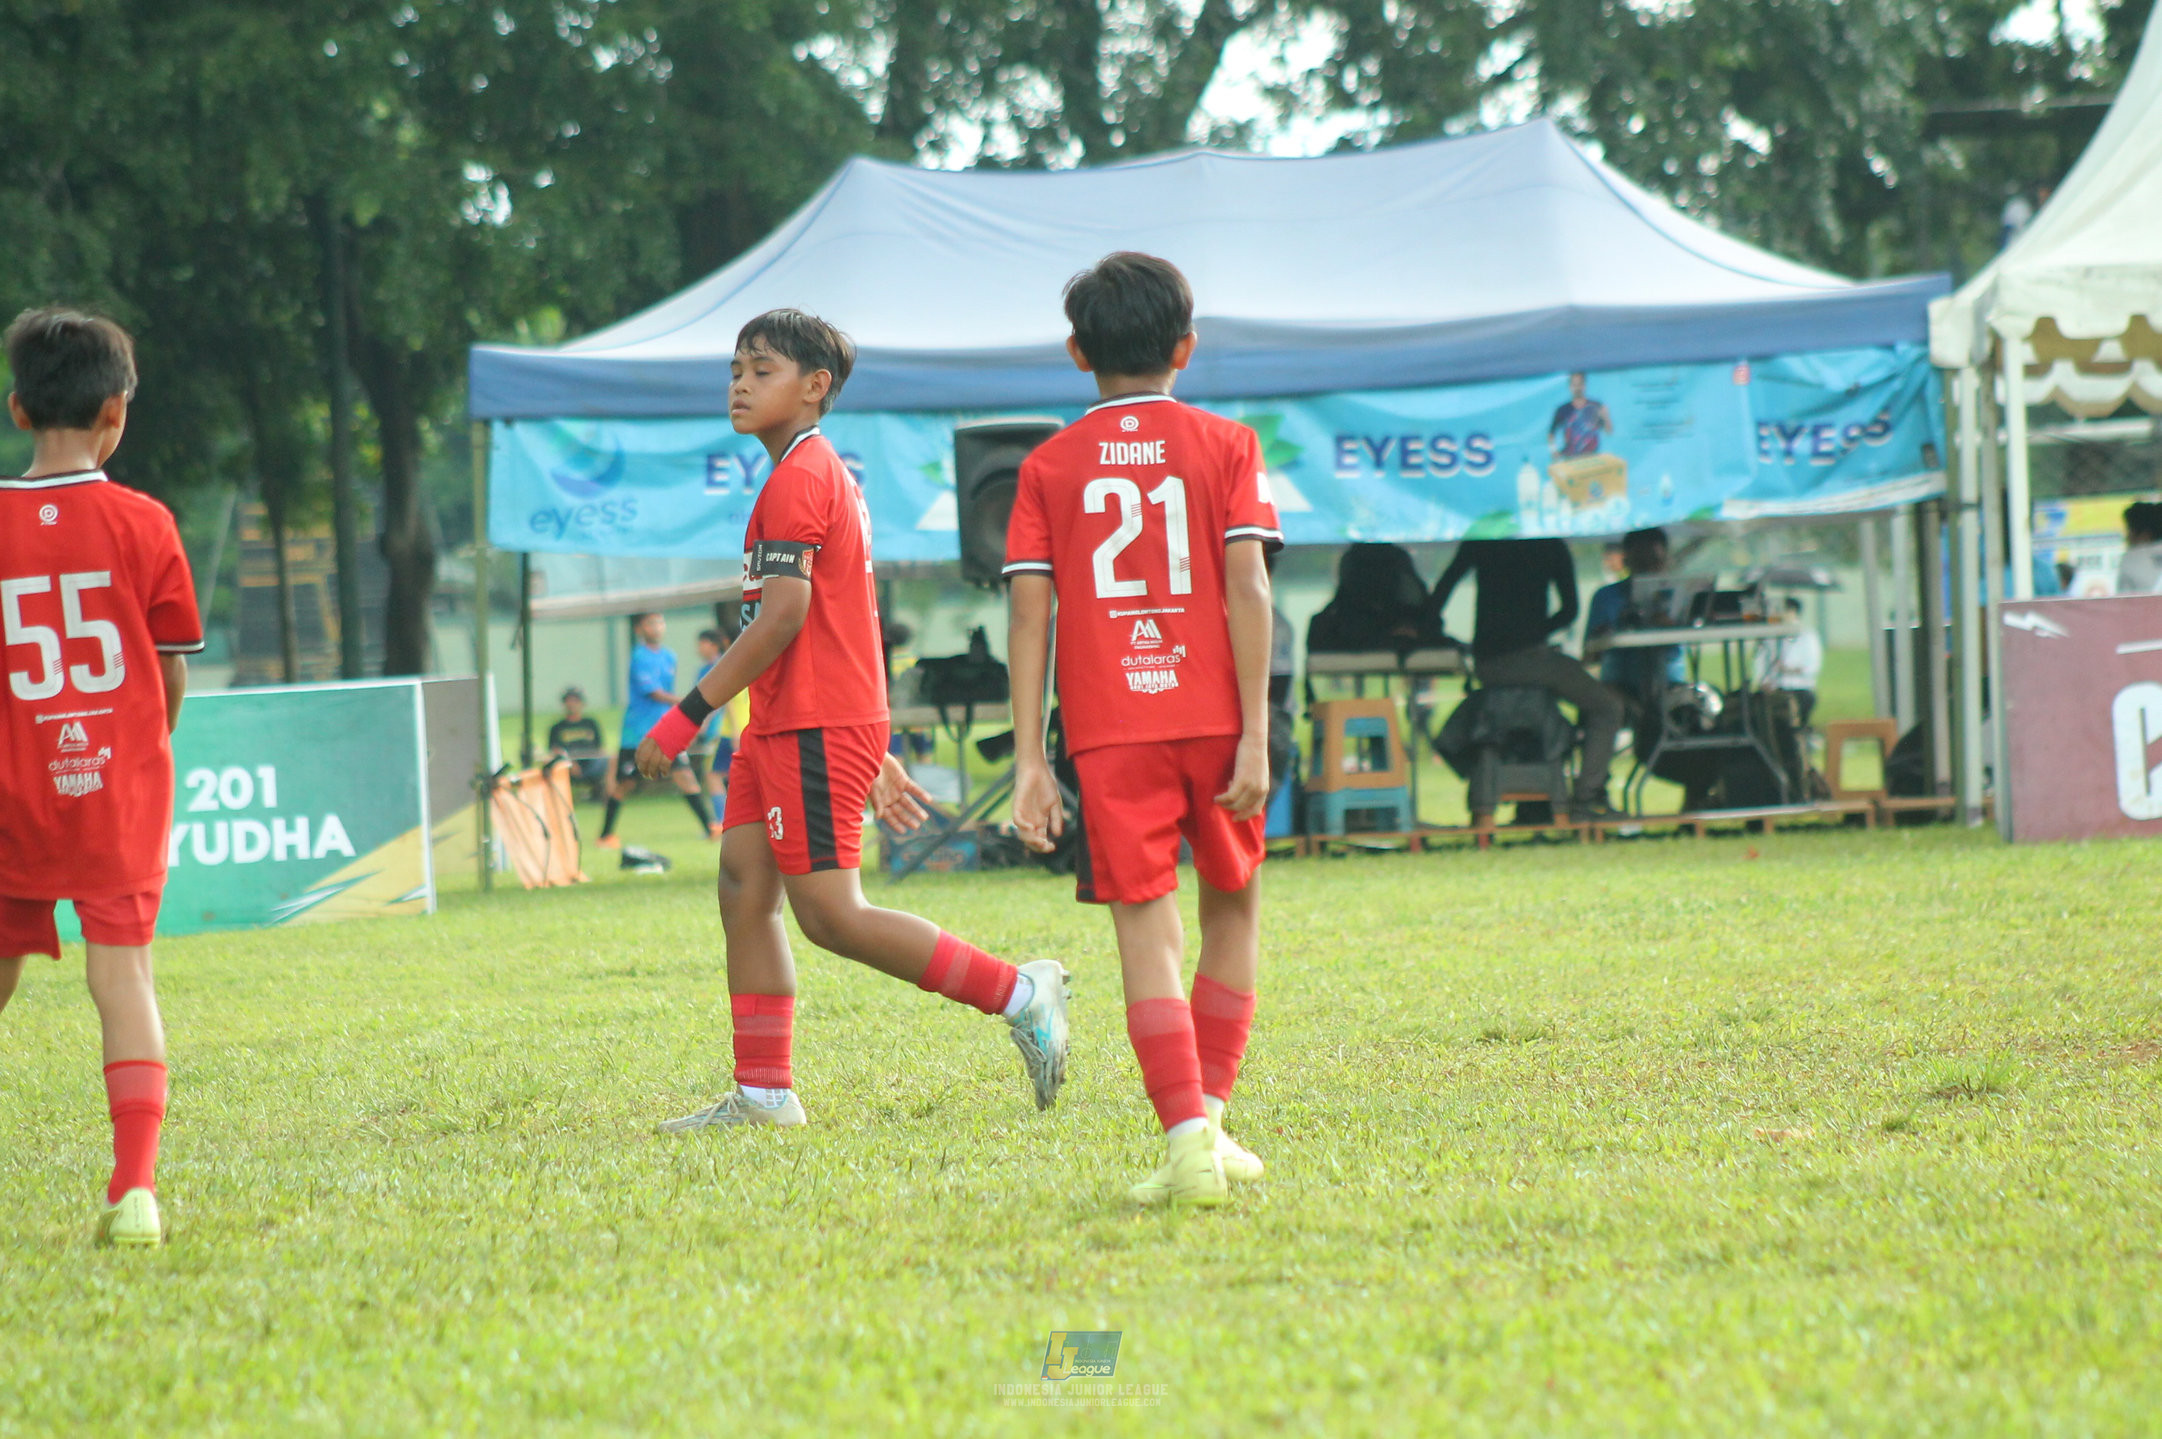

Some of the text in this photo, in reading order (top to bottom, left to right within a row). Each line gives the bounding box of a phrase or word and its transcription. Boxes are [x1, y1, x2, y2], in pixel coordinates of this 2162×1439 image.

[1099, 440, 1166, 465] ZIDANE
[1334, 434, 1496, 478] EYESS
[704, 453, 868, 495] EYS
[1083, 475, 1192, 599] 21
[1, 570, 126, 701] 55
[1121, 654, 1181, 667] dutalaras
[1125, 669, 1179, 690] YAMAHA
[53, 771, 103, 794] YAMAHA
[185, 765, 278, 812] 201
